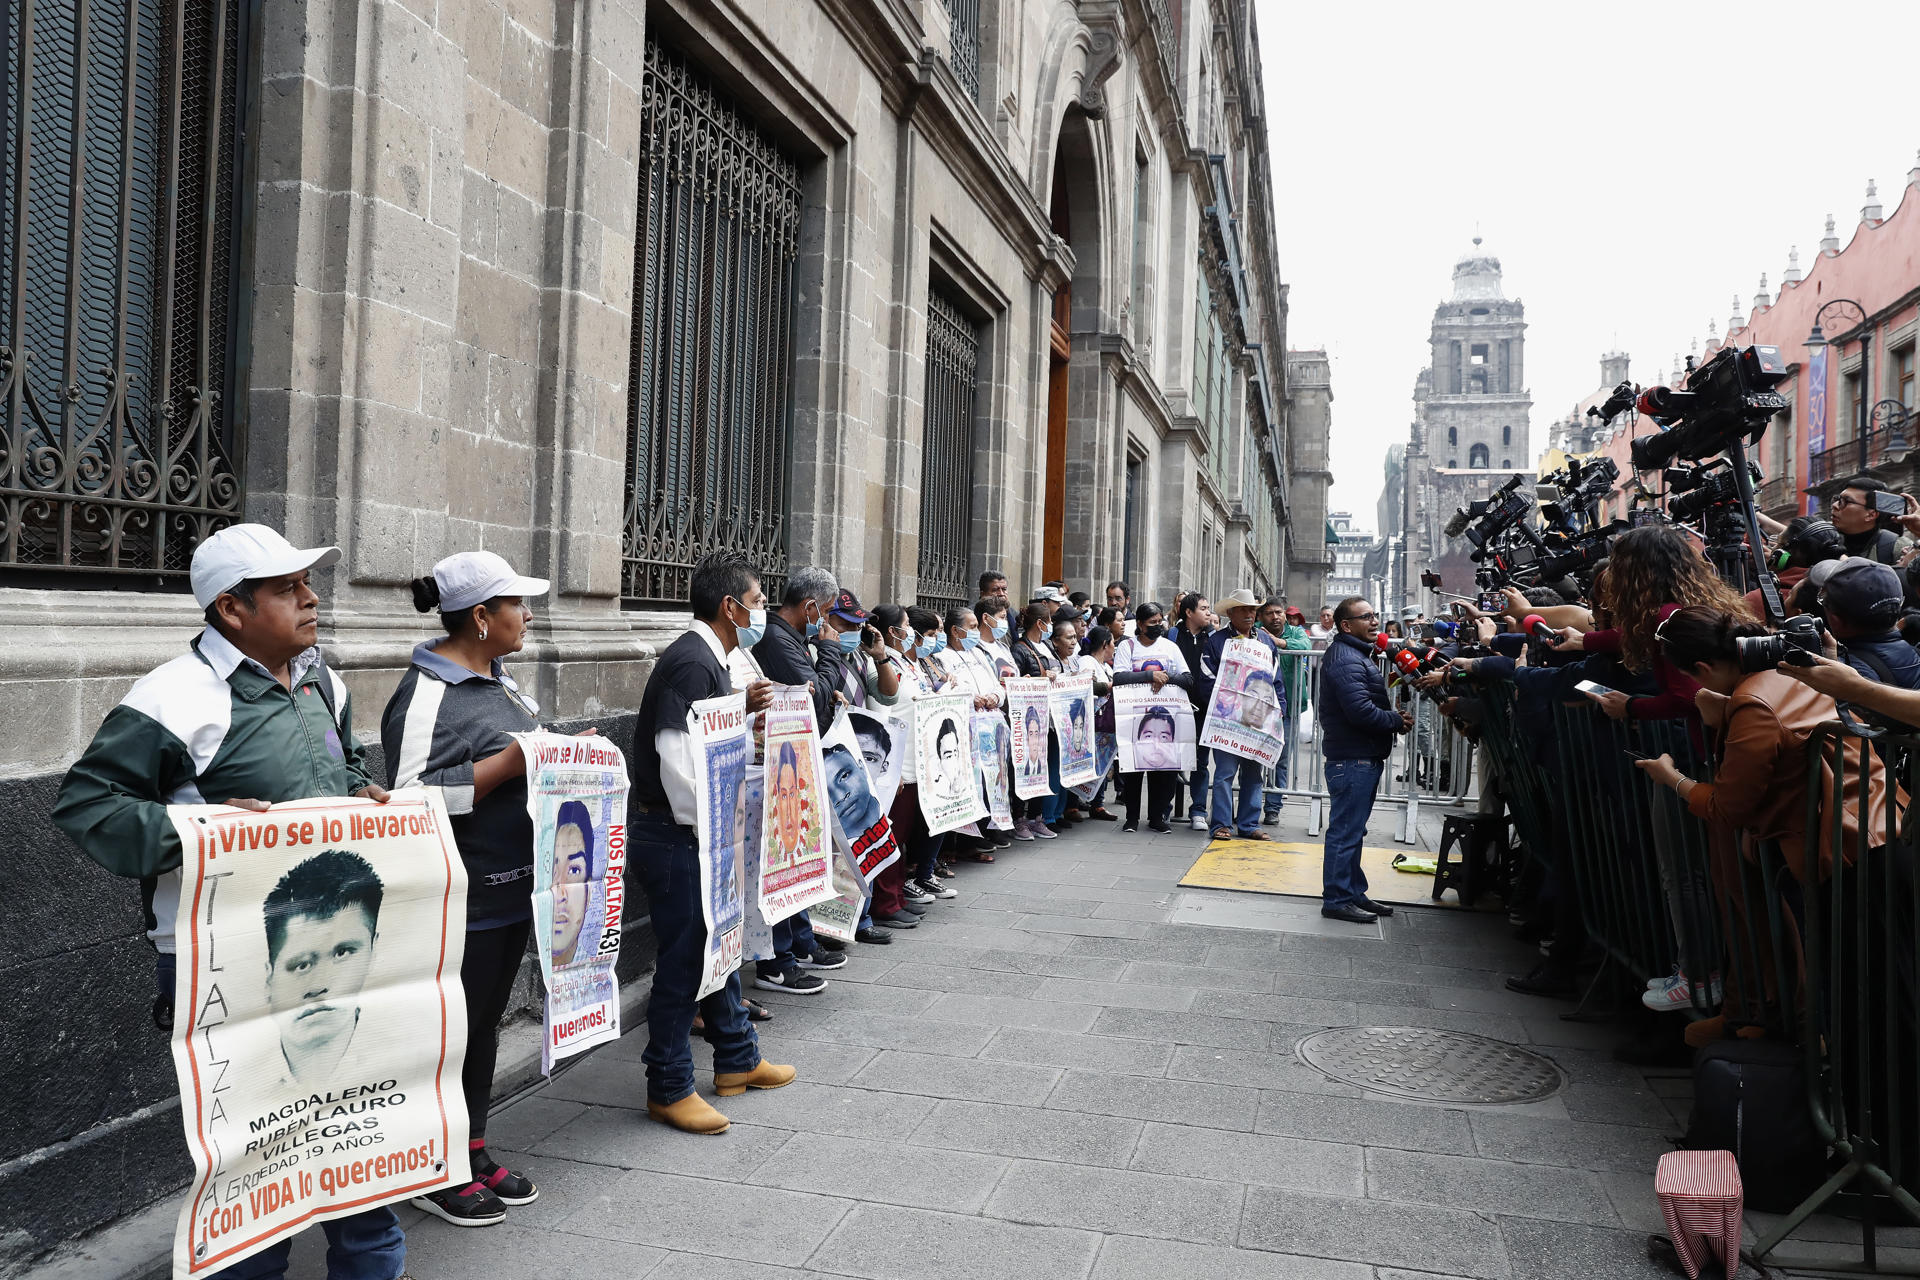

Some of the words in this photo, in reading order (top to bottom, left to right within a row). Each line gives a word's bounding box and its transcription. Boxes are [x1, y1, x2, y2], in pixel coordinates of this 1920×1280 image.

[703, 709, 733, 736] ¡Vivo
[1014, 720, 1024, 747] FALTAN
[560, 746, 571, 764] se
[573, 742, 583, 764] lo
[1016, 748, 1024, 764] NOS
[1230, 740, 1238, 749] lo
[209, 819, 279, 860] ¡Vivo
[286, 821, 314, 847] se
[321, 815, 343, 844] lo
[350, 809, 435, 841] llevaron!
[609, 824, 625, 861] NOS
[605, 865, 623, 928] FALTAN
[598, 928, 620, 957] 43!
[245, 1113, 310, 1156] RUBÉN
[314, 1092, 407, 1122] LAURO
[249, 1079, 398, 1134] MAGDALENO
[259, 1154, 300, 1180] EDAD
[305, 1145, 324, 1160] 19
[332, 1132, 386, 1154] AÑOS
[263, 1116, 379, 1161] VILLEGAS
[202, 1202, 243, 1246] ¡Con
[249, 1176, 295, 1221] VIDA
[298, 1170, 313, 1200] lo
[319, 1138, 435, 1197] queremos!
